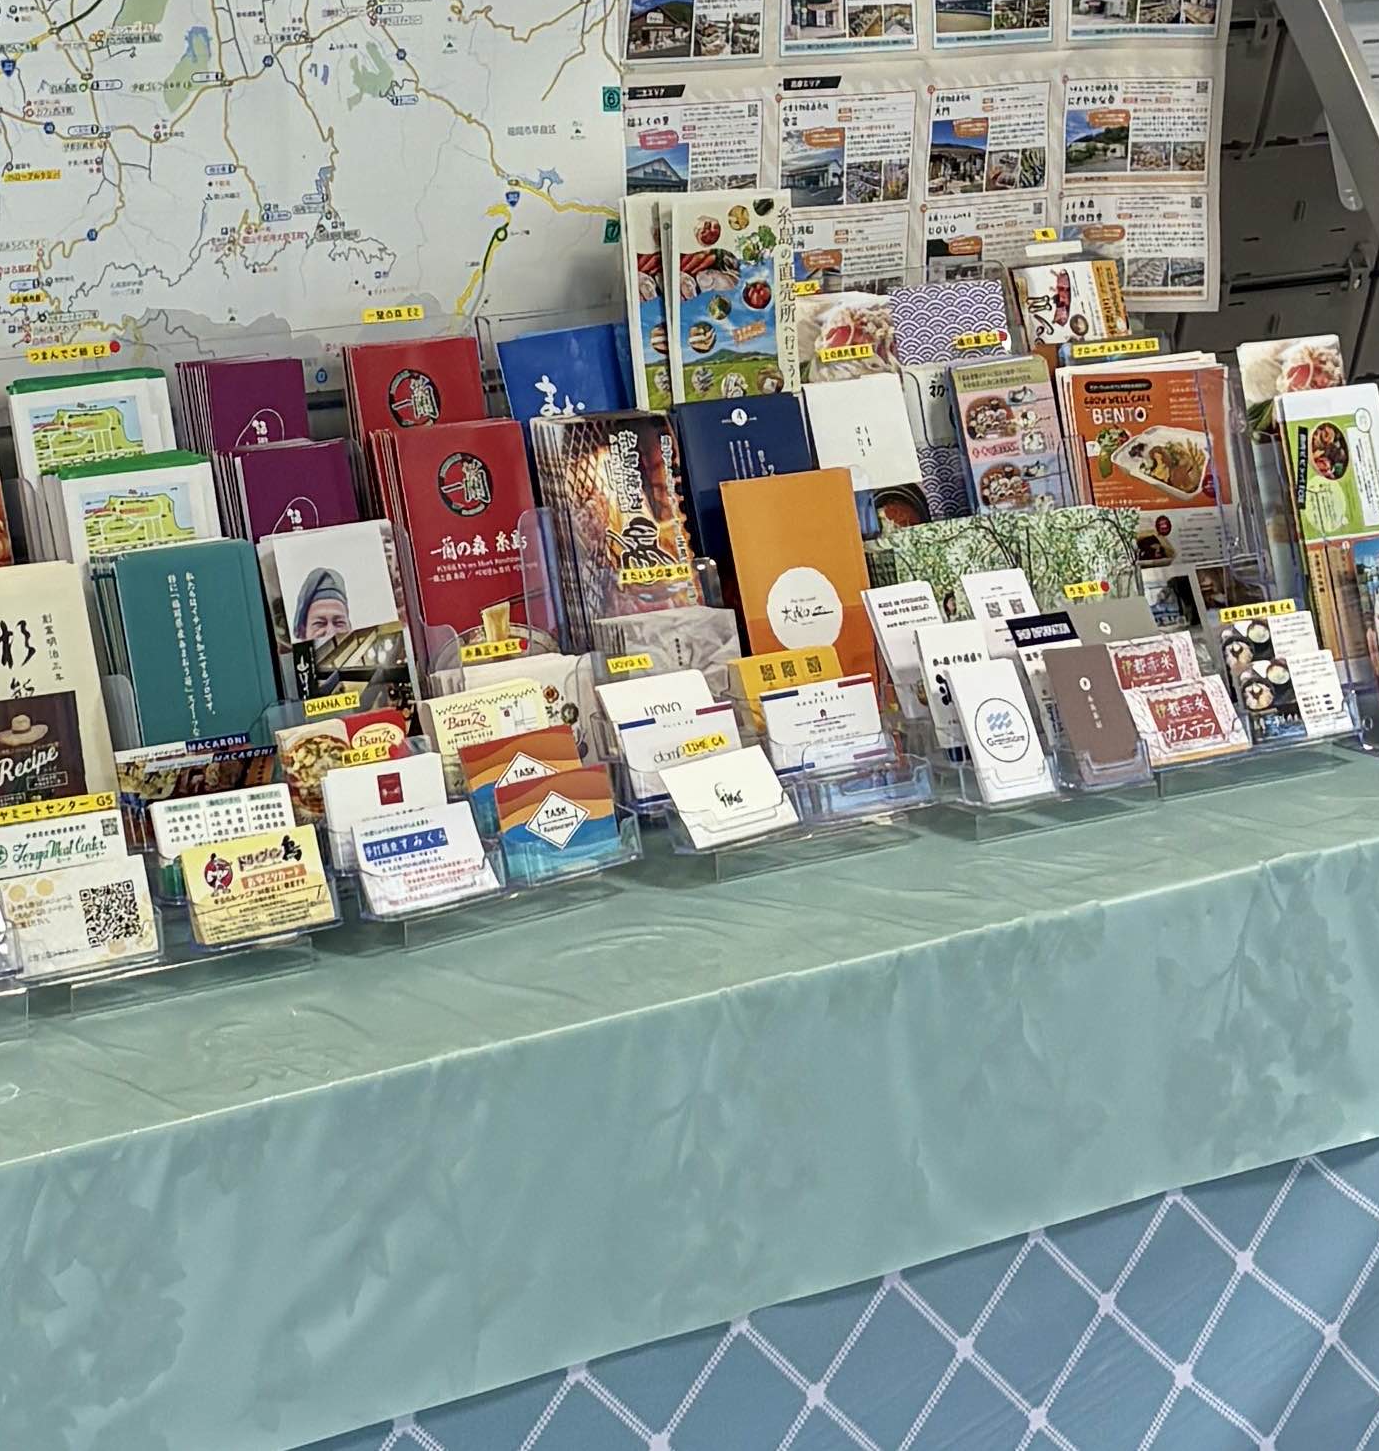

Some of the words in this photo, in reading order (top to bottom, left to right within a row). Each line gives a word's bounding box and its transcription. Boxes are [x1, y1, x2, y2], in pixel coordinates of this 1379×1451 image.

[1092, 406, 1148, 426] BENTO
[185, 734, 247, 751] MACARONI
[513, 766, 538, 780] TASK
[544, 804, 569, 820] TASK
